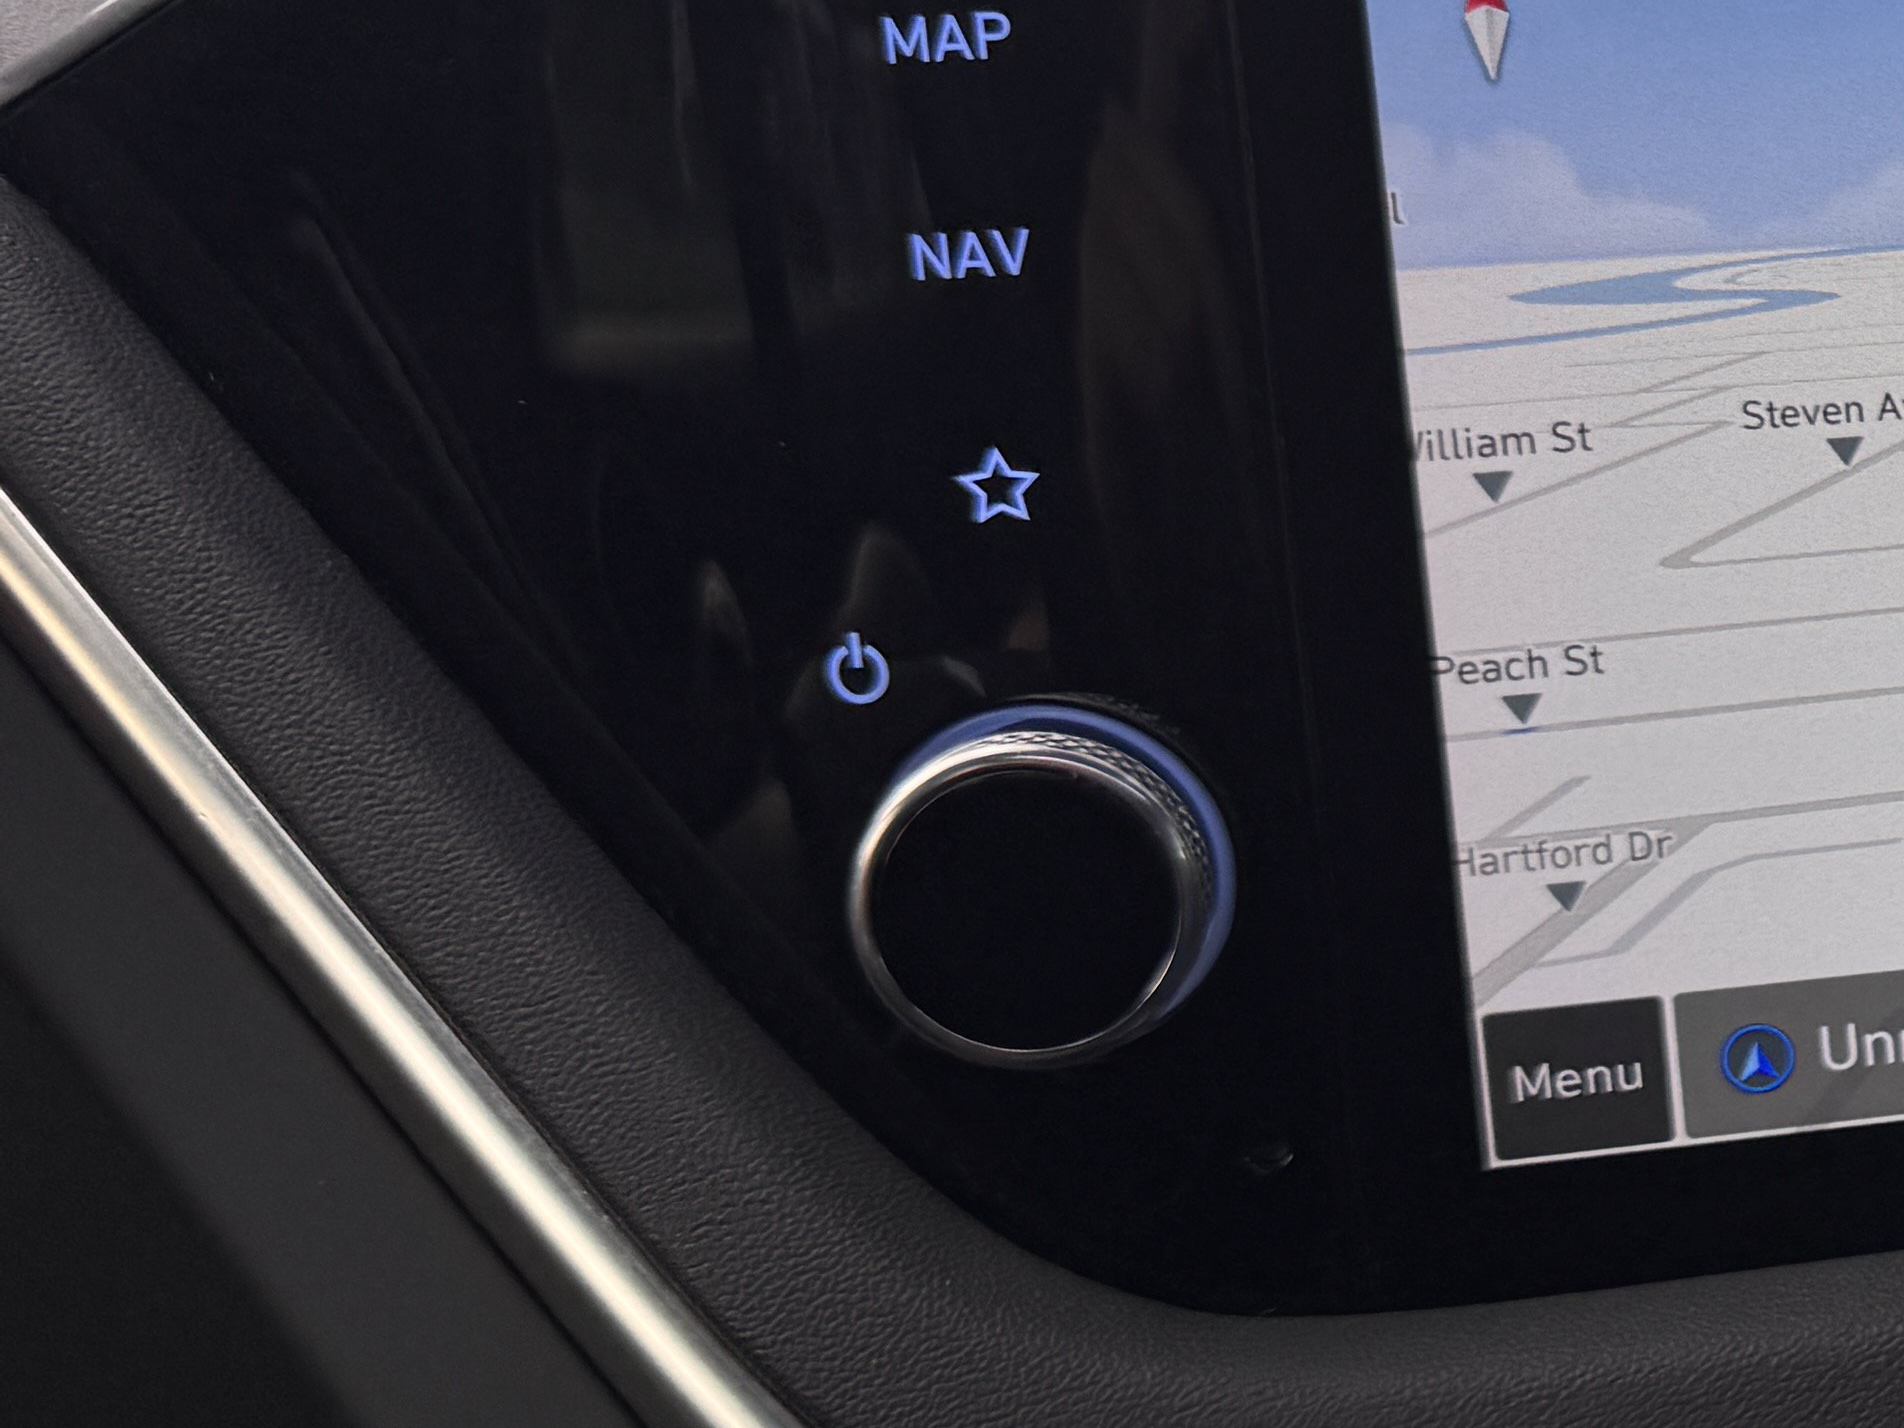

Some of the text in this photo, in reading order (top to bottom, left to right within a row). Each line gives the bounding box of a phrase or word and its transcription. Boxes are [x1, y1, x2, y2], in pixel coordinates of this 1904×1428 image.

[880, 11, 1011, 64] MAP
[908, 228, 1030, 281] NAV
[1742, 395, 1864, 430] Steven
[1550, 420, 1592, 453] St
[1564, 644, 1605, 677] St
[1630, 828, 1675, 860] Dr
[1512, 1058, 1645, 1103] Menu
